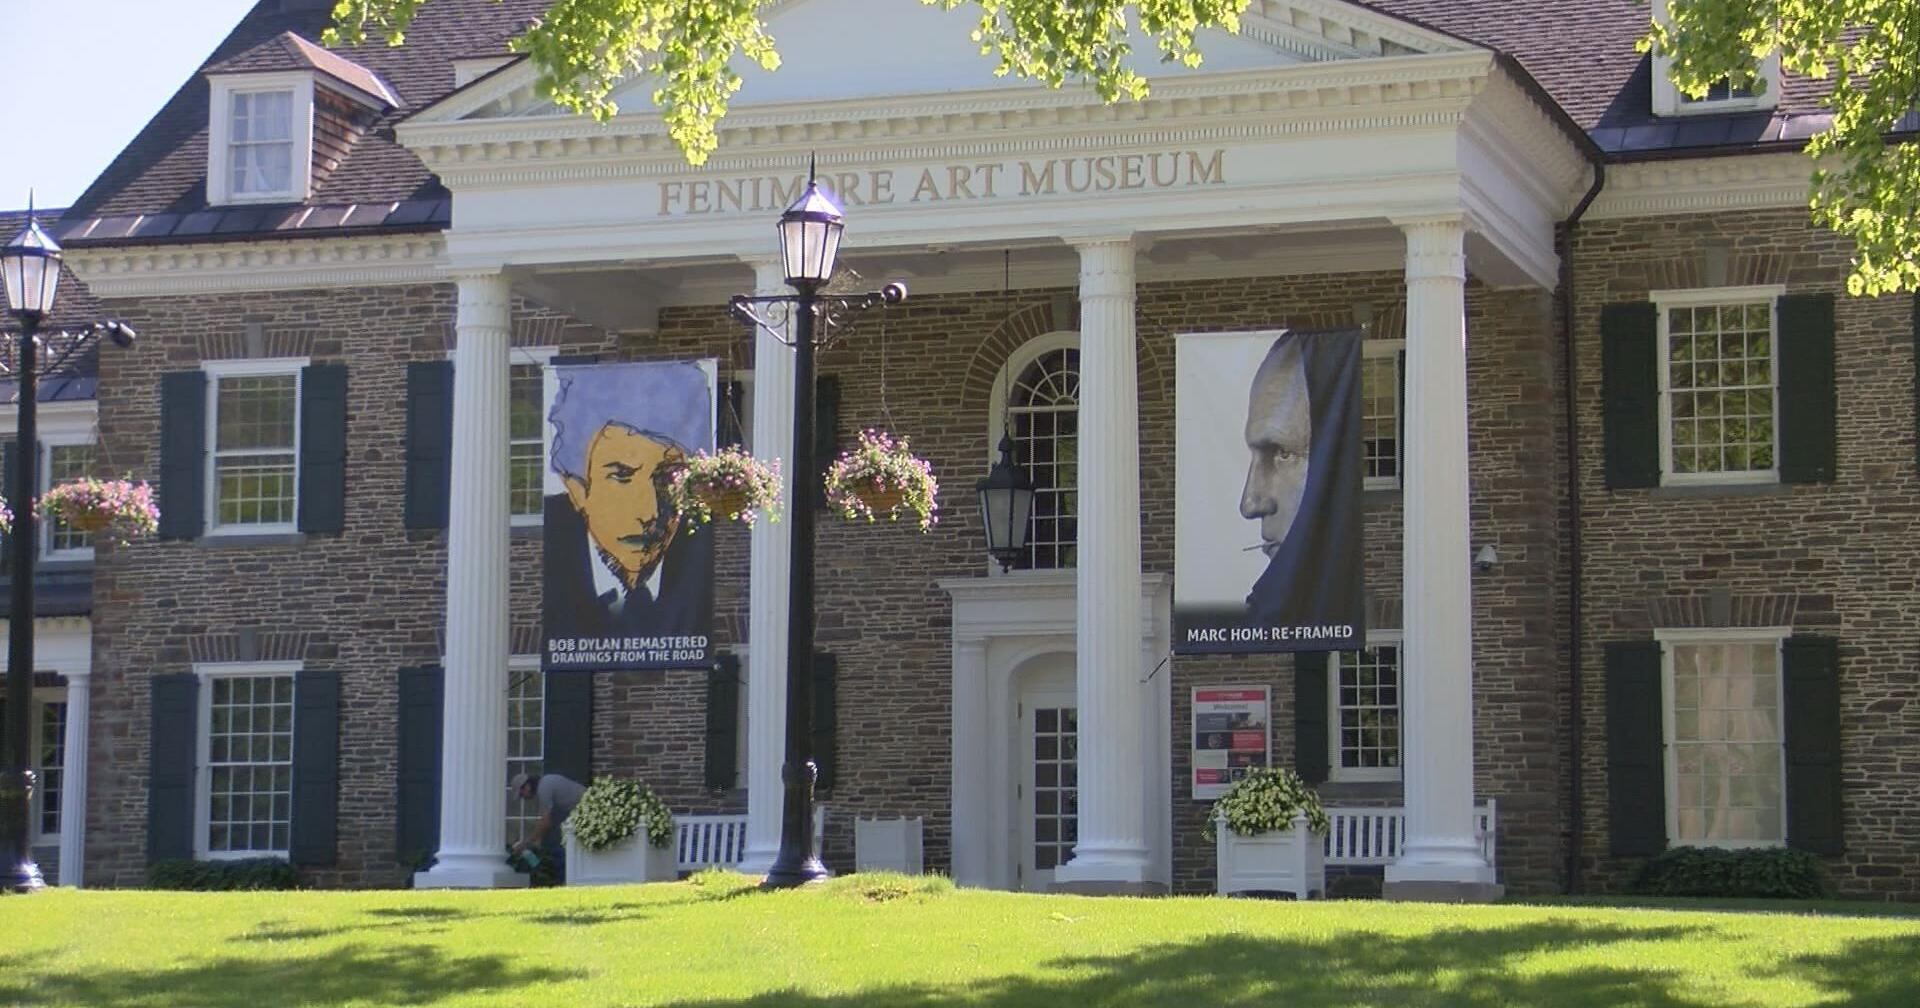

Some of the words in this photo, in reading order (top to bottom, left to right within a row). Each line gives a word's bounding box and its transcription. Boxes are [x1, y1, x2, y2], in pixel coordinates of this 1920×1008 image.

[657, 169, 896, 216] FENIMORE
[911, 163, 1003, 203] ART
[1018, 149, 1225, 196] MUSEUM
[1187, 628, 1226, 641] MARC
[1231, 627, 1268, 641] HOM:
[1272, 625, 1353, 639] RE-FRAMED
[549, 639, 576, 651] BOB
[579, 637, 620, 650] DYLAN
[623, 636, 707, 649] REMASTERED
[551, 651, 611, 663] DRAWINGS
[613, 651, 646, 662] FROM
[649, 650, 669, 661] THE
[673, 649, 705, 661] ROAD
